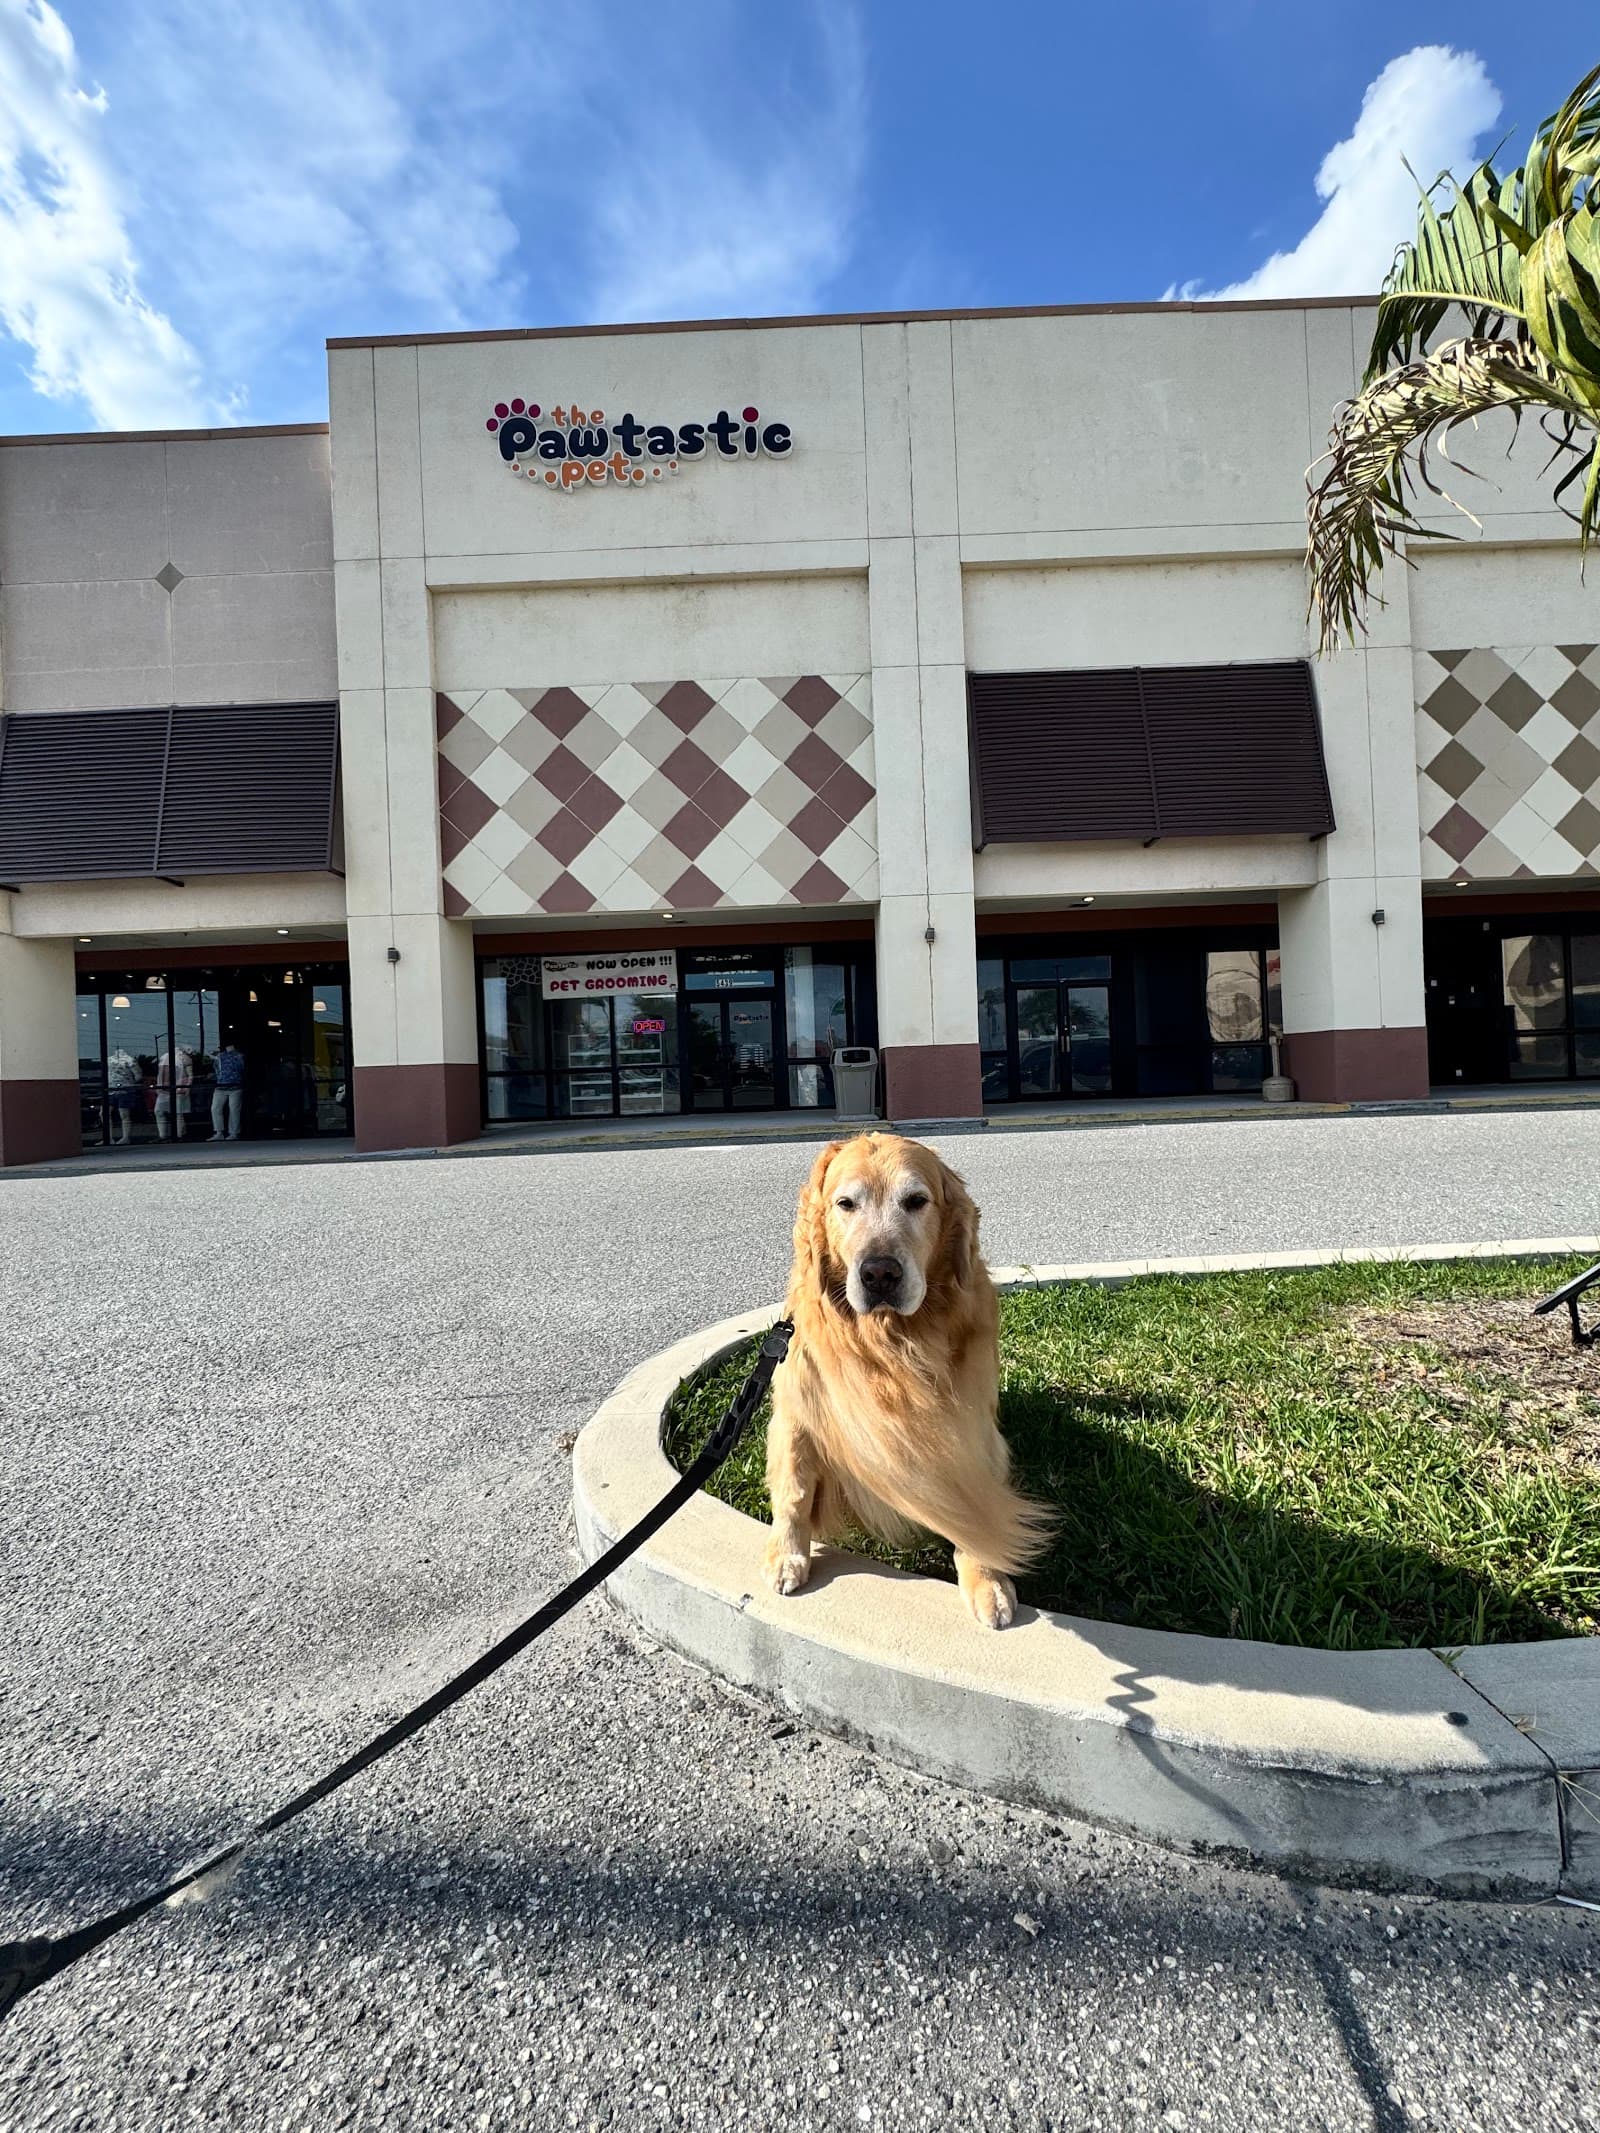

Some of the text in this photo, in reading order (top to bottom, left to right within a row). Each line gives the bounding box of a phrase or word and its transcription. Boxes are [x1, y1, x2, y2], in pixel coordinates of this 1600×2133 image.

[550, 404, 606, 428] the
[498, 406, 793, 462] Pawtastic
[561, 451, 632, 490] pet
[586, 956, 672, 970] NOW OPEN !!!
[550, 975, 668, 992] PET GROOMING
[635, 1021, 663, 1031] OPEN
